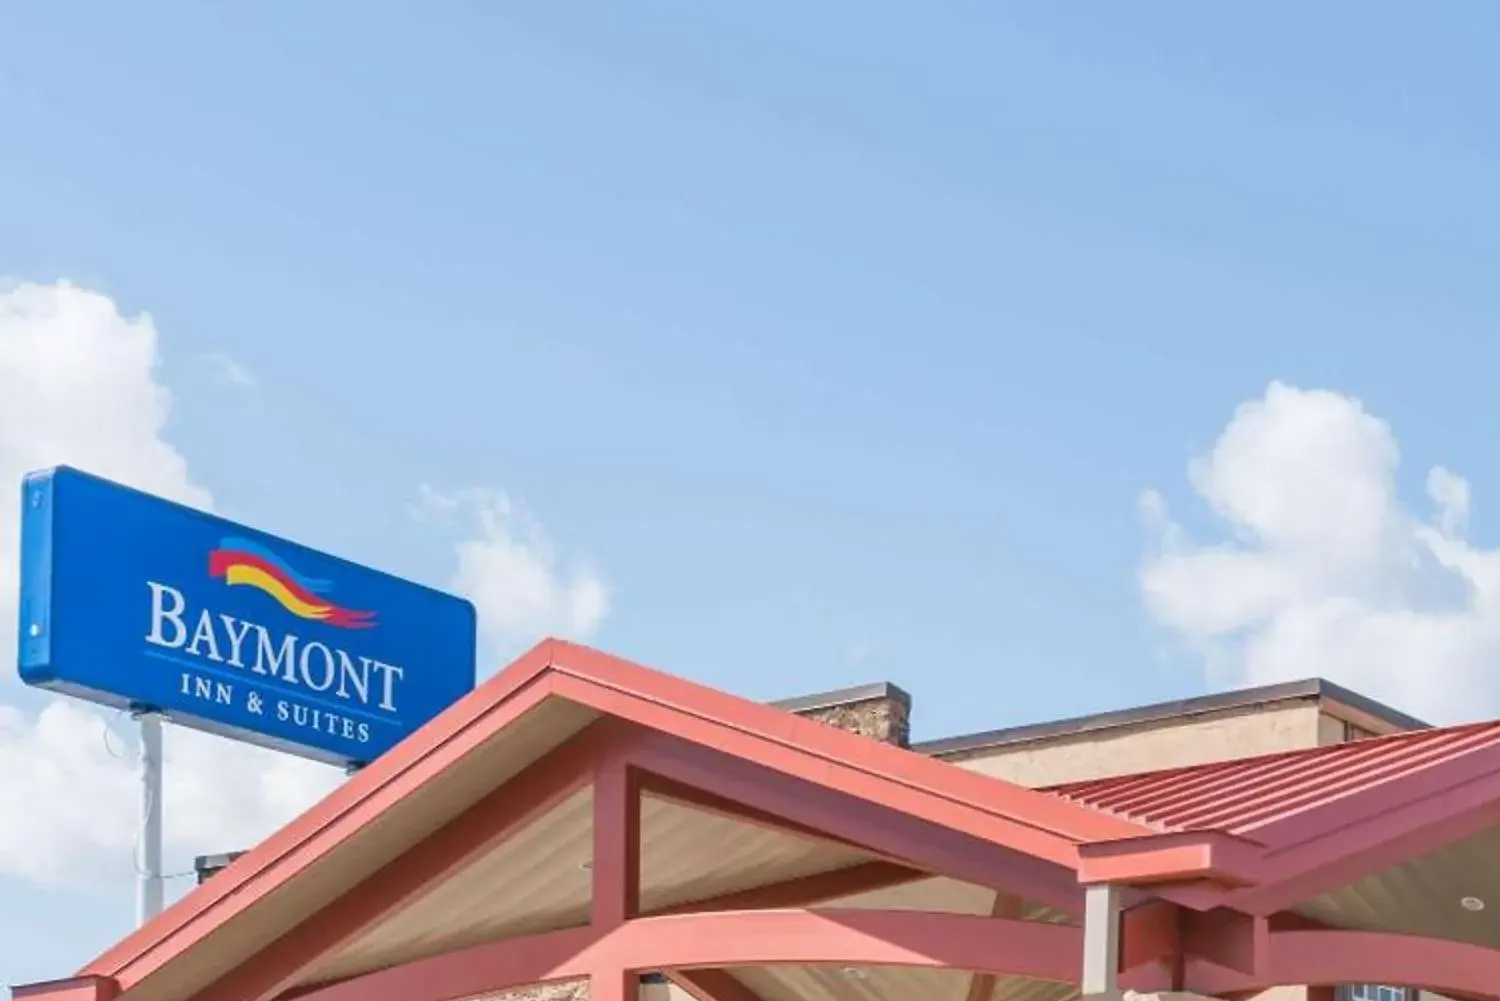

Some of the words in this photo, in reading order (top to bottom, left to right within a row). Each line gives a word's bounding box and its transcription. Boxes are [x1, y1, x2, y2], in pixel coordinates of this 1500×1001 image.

[145, 581, 404, 712] BAYMONT
[181, 673, 234, 705] INN
[247, 691, 263, 716] &
[277, 701, 370, 743] SUITES
